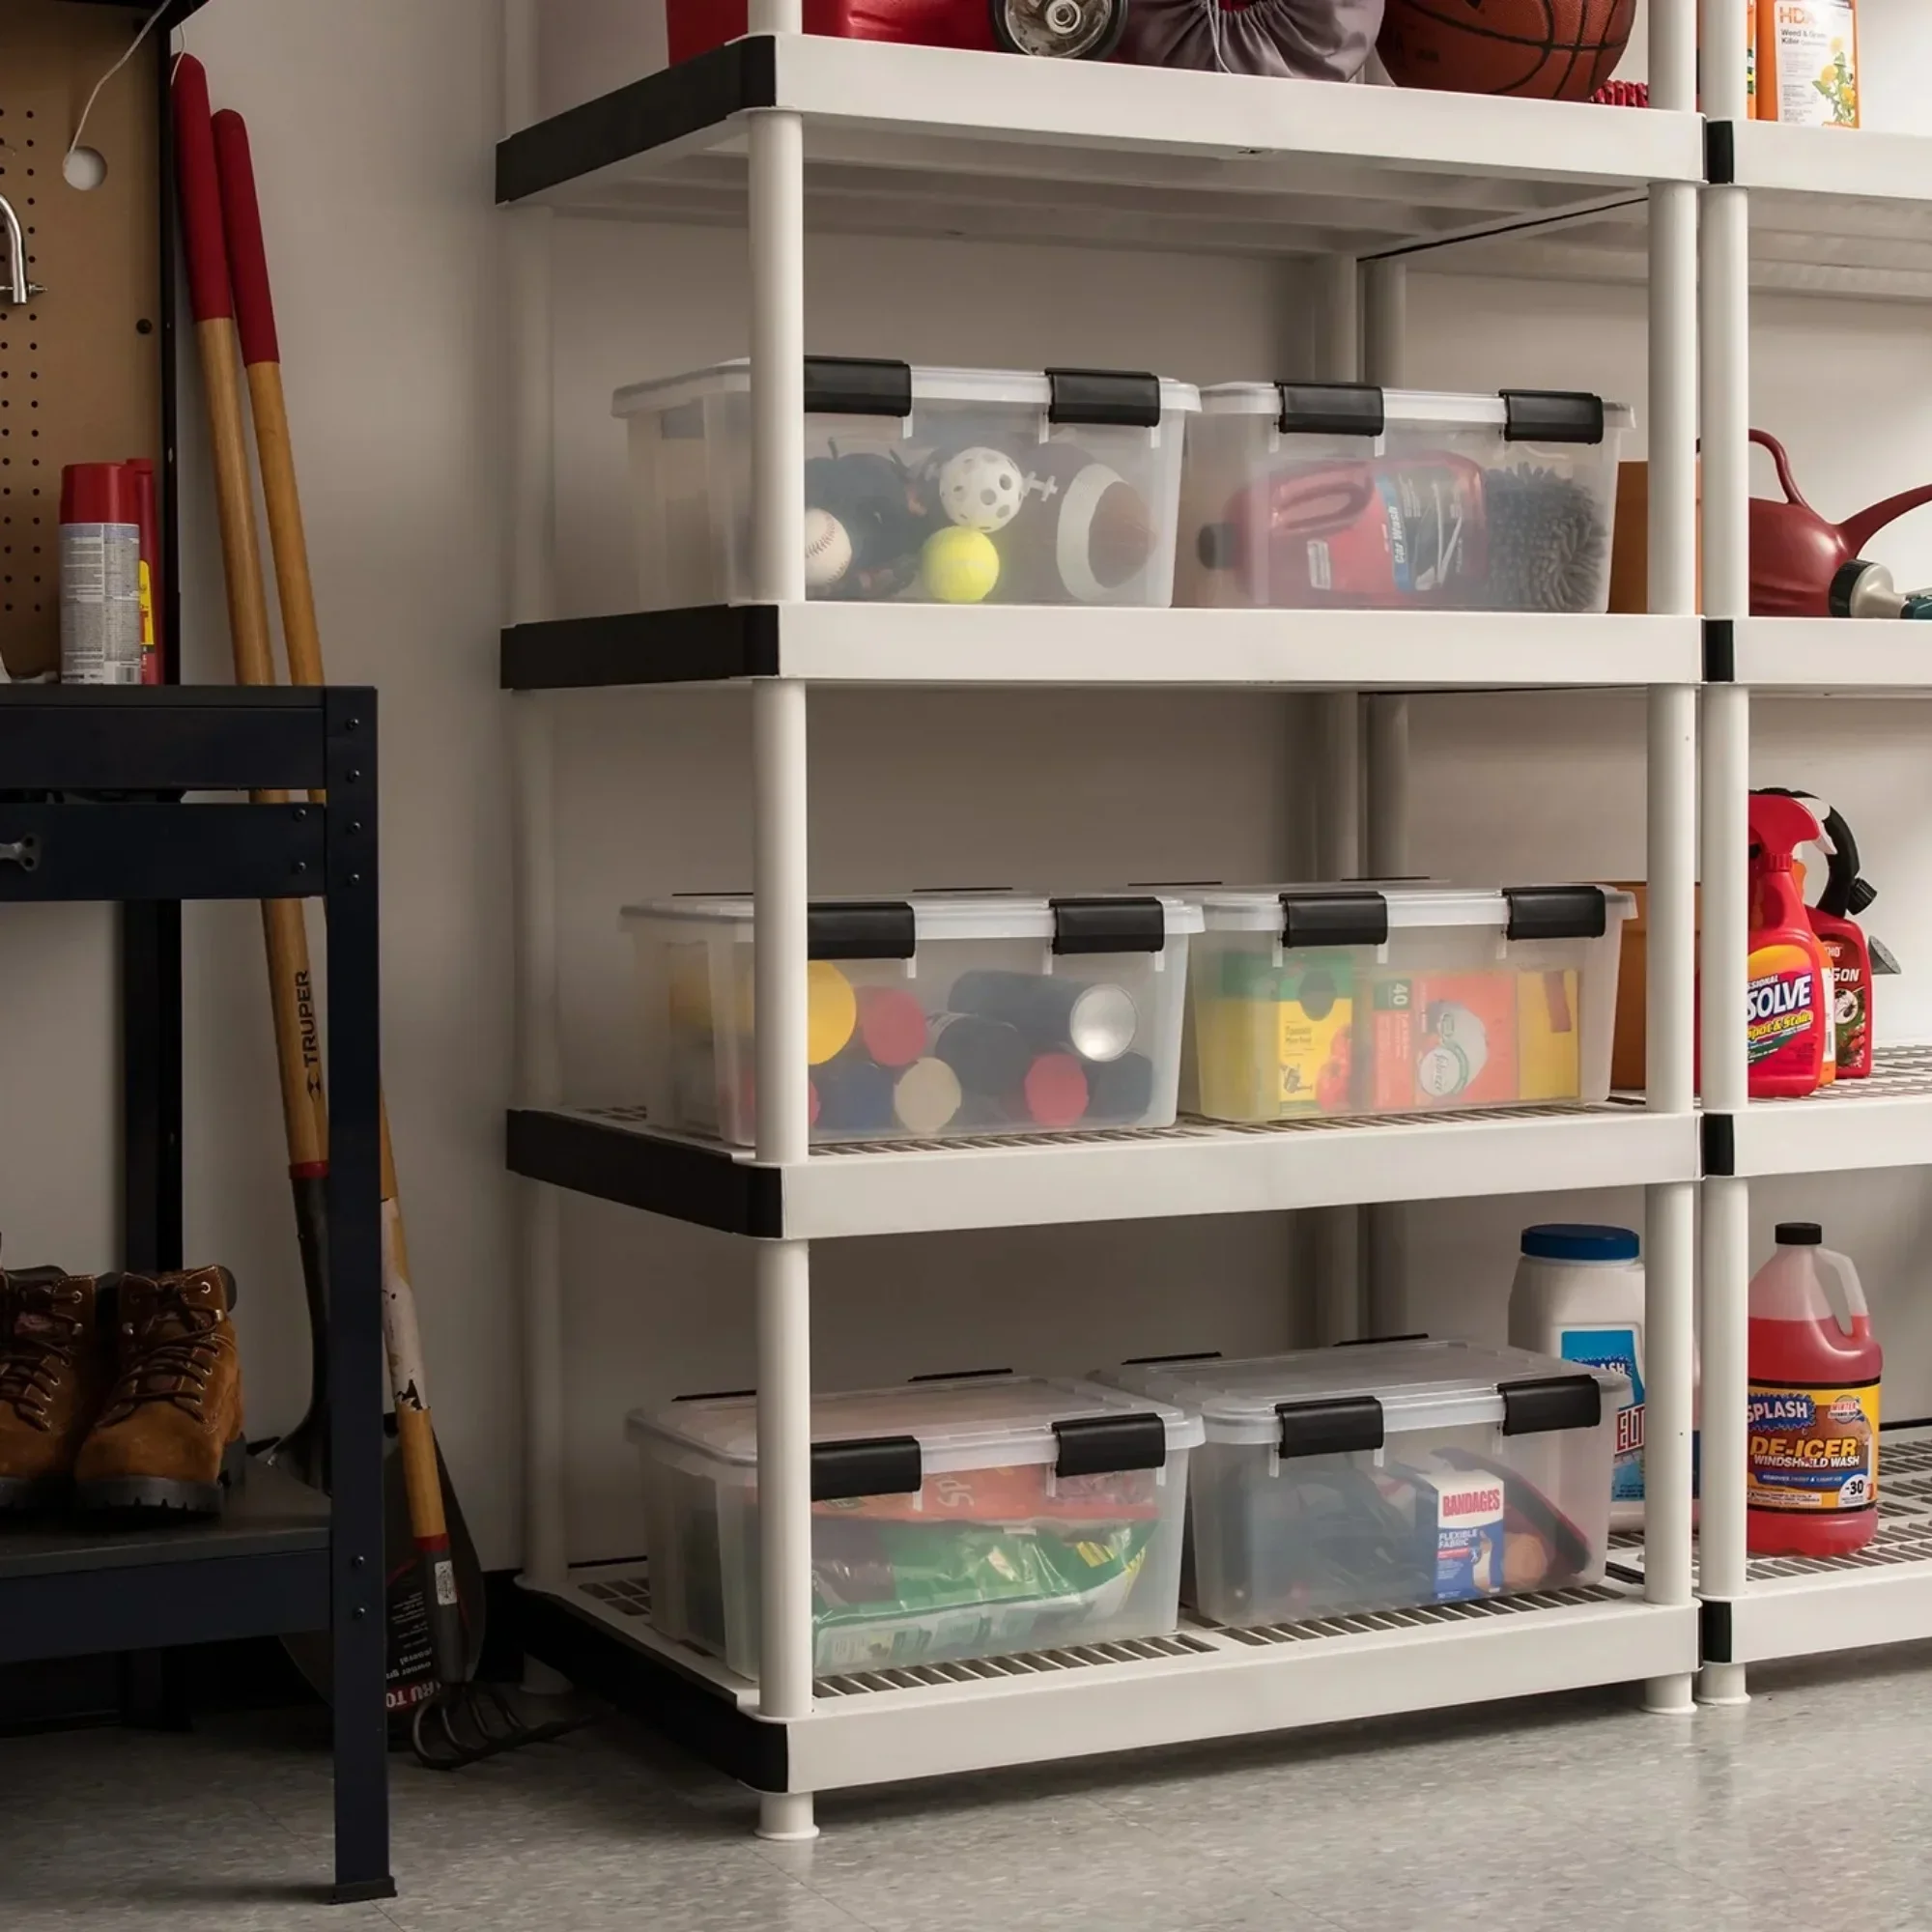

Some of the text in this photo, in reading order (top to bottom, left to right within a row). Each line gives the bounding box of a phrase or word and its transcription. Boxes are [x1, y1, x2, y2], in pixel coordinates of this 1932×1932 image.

[1392, 982, 1408, 1006] 40
[1747, 975, 1811, 1022] SOLVE
[295, 970, 318, 1068] TRUPER
[1773, 1020, 1781, 1032] &
[1783, 1012, 1811, 1028] Stain
[1747, 1401, 1808, 1423] SPLASH
[1750, 1435, 1858, 1458] DE-ICER
[1831, 1456, 1860, 1467] WASH
[1845, 1479, 1864, 1495] -30
[1442, 1489, 1501, 1517] BANDAGES
[1438, 1529, 1478, 1541] FLEXIBLE
[410, 1681, 441, 1702] RU
